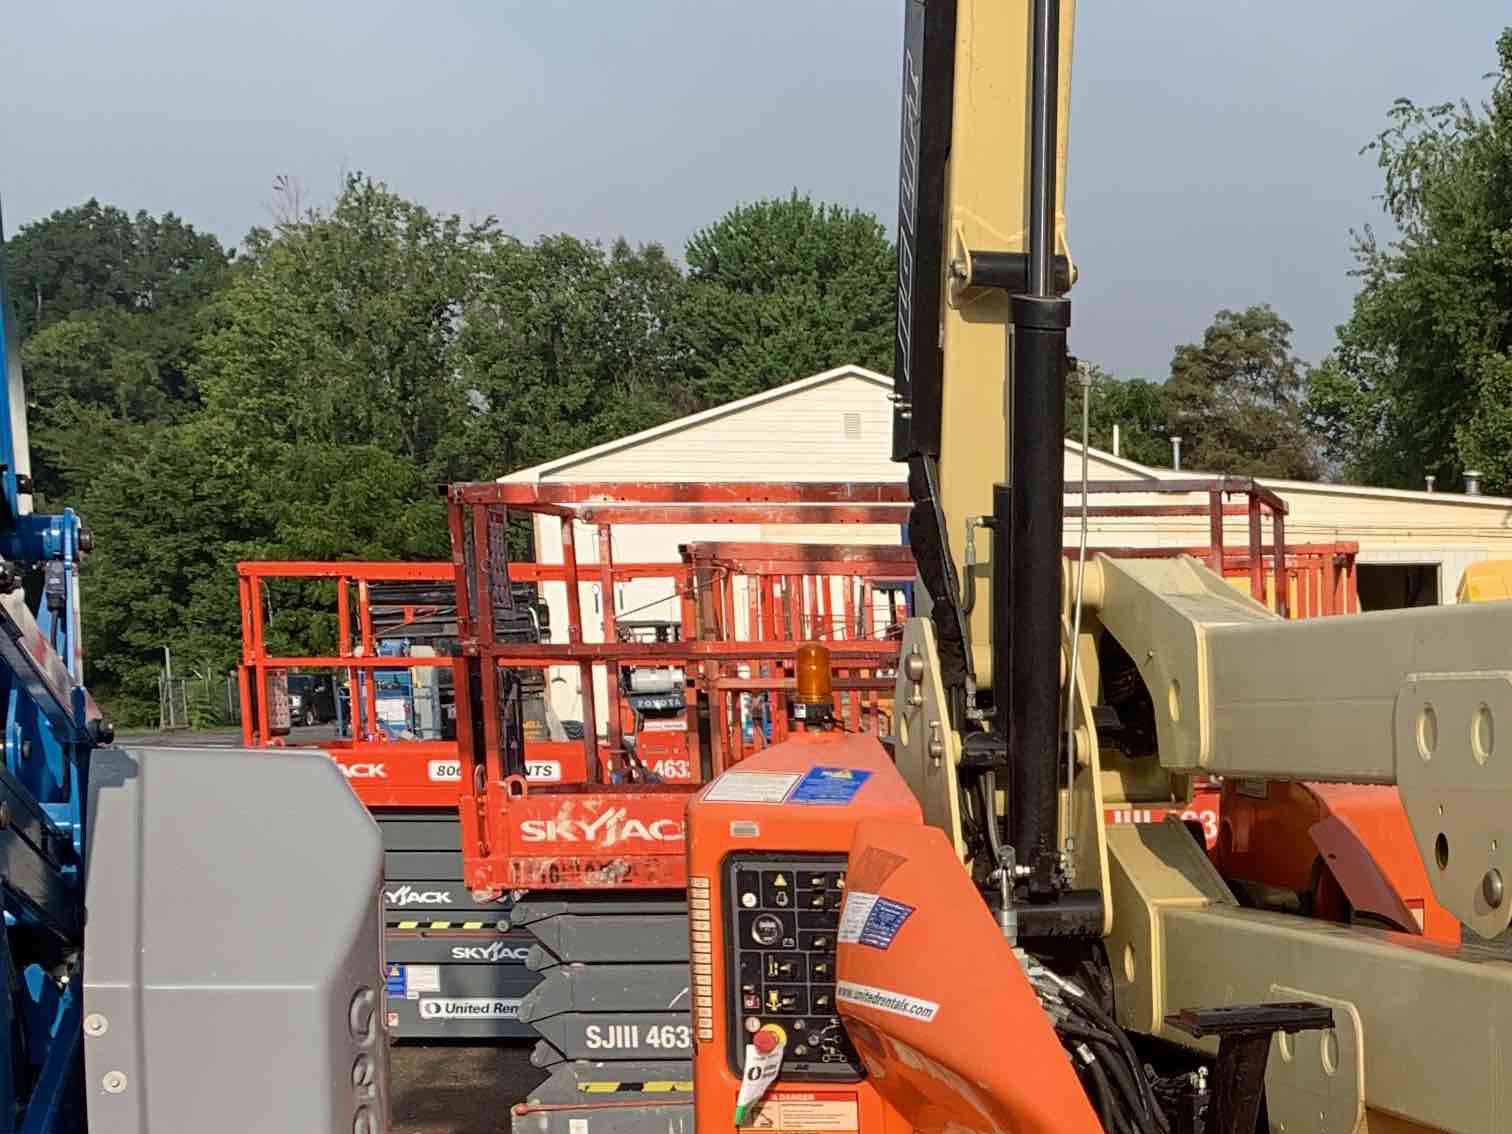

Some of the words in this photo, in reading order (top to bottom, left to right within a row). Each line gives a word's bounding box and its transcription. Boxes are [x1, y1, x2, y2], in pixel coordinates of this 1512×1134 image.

[653, 758, 691, 778] 463
[520, 806, 686, 848] SKYJAC
[385, 885, 452, 906] YJACK
[451, 941, 529, 961] SKYJAC
[445, 1003, 489, 1015] United
[645, 1025, 693, 1049] 463
